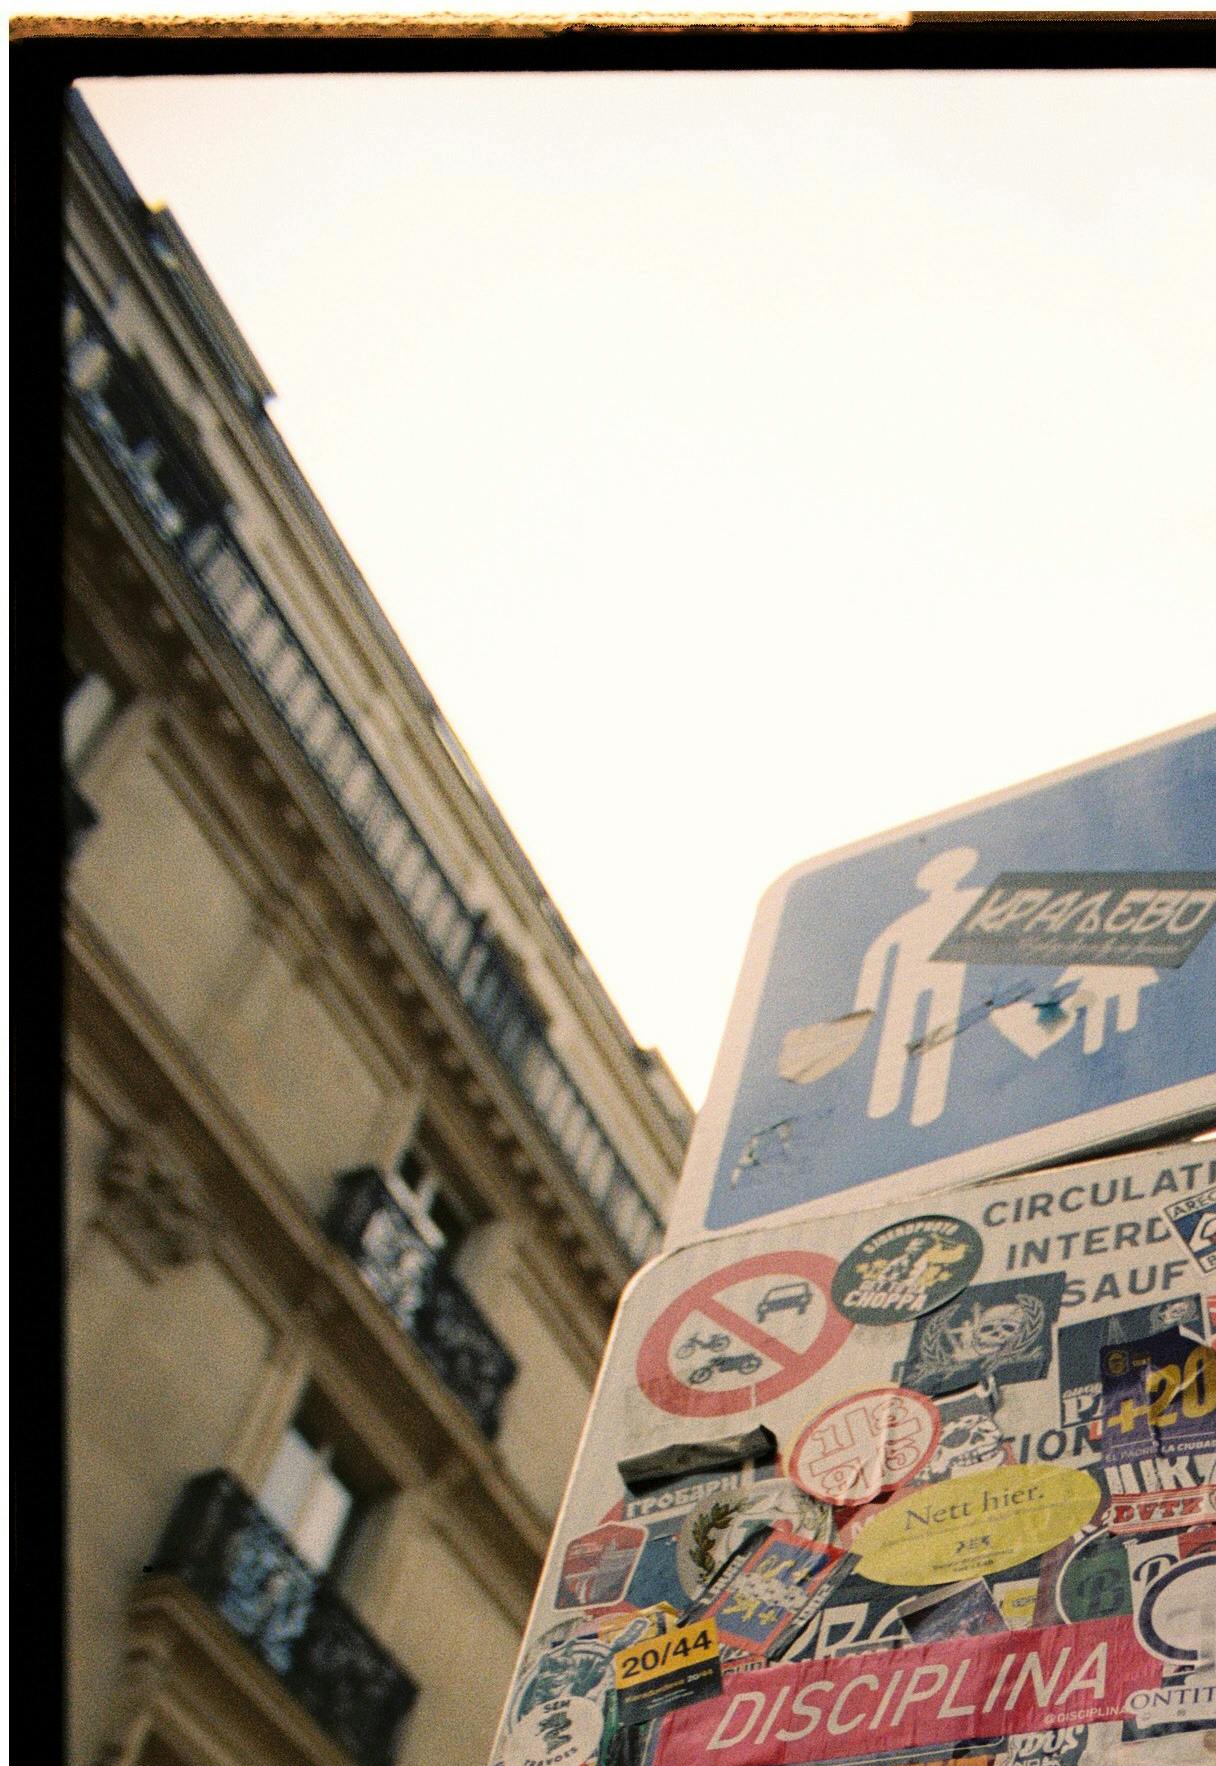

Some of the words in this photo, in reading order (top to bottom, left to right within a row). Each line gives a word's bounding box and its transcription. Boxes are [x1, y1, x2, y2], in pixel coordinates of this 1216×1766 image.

[1005, 1216, 1171, 1272] INTERD
[1060, 1259, 1189, 1308] SAUF
[903, 1501, 971, 1531] Nett
[982, 1483, 1045, 1514] hier.
[621, 1628, 713, 1680] 20/44
[706, 1641, 1108, 1751] DISCIPLINA
